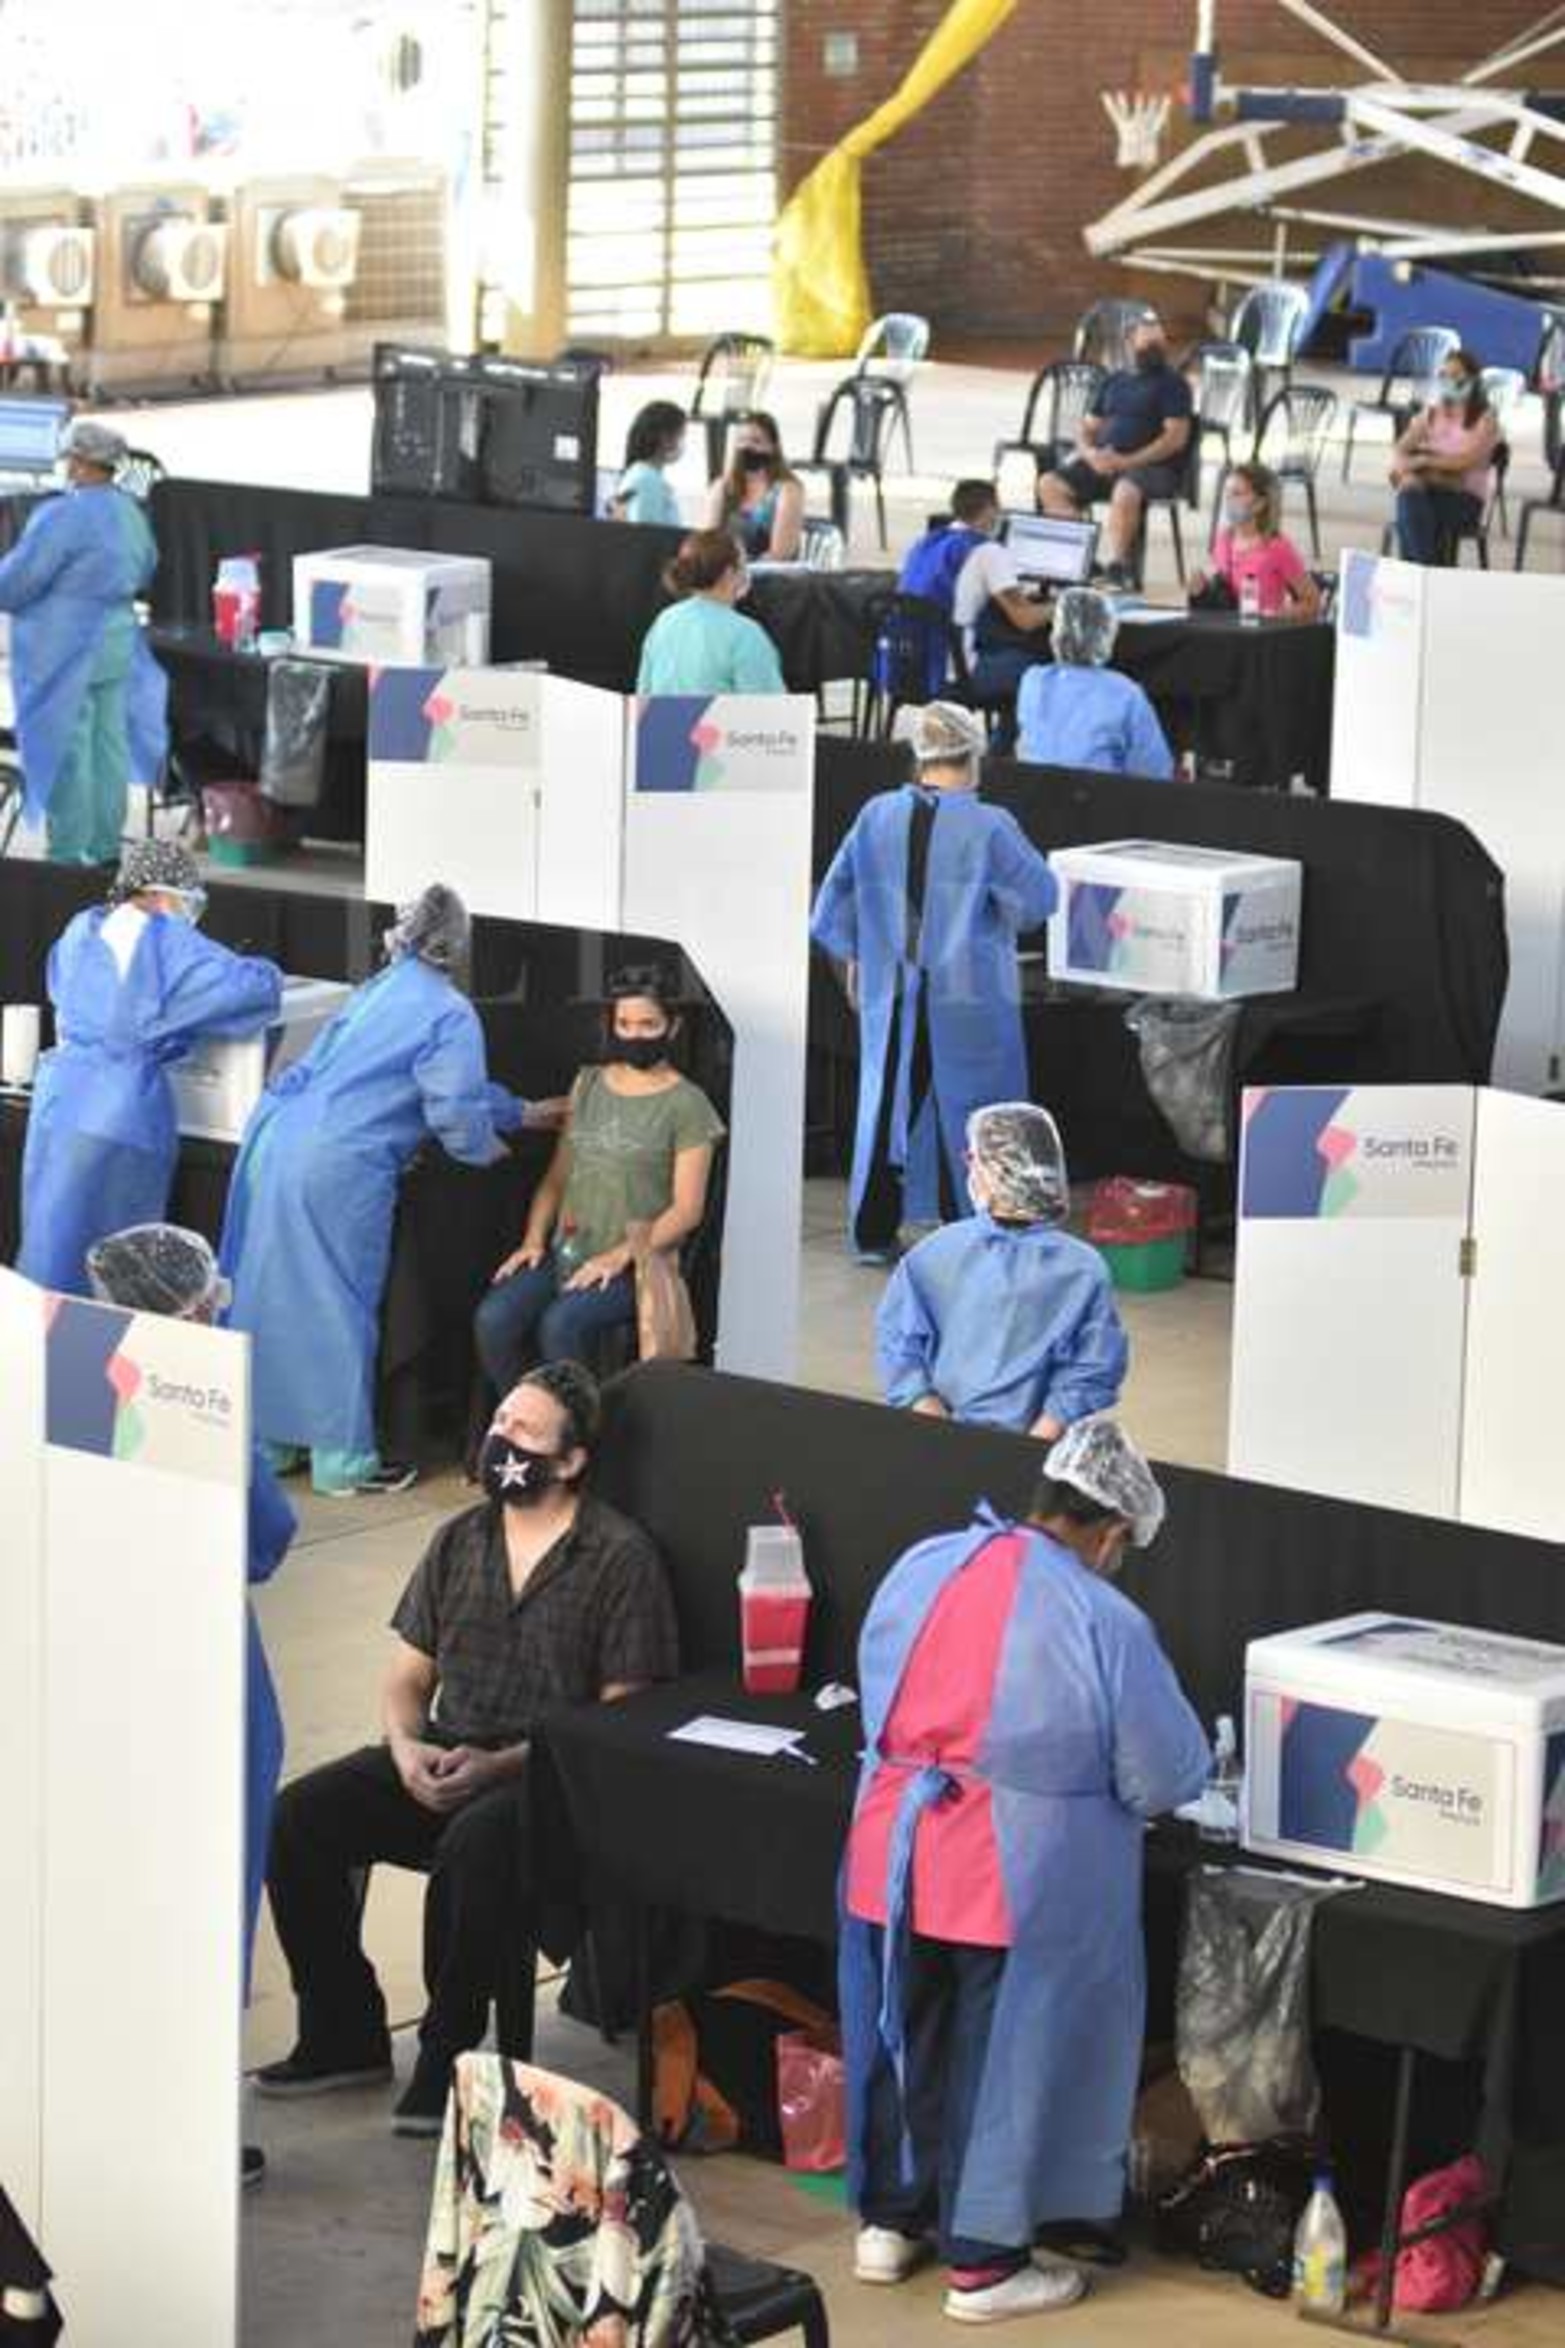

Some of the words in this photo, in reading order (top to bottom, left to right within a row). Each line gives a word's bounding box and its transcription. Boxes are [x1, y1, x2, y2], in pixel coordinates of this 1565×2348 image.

[1364, 1136, 1429, 1158] Santa
[1433, 1136, 1459, 1157] Fe
[148, 1373, 207, 1410] Santa
[208, 1387, 231, 1414] Fe
[1391, 1774, 1454, 1808] Santa
[1458, 1787, 1483, 1813] Fe
